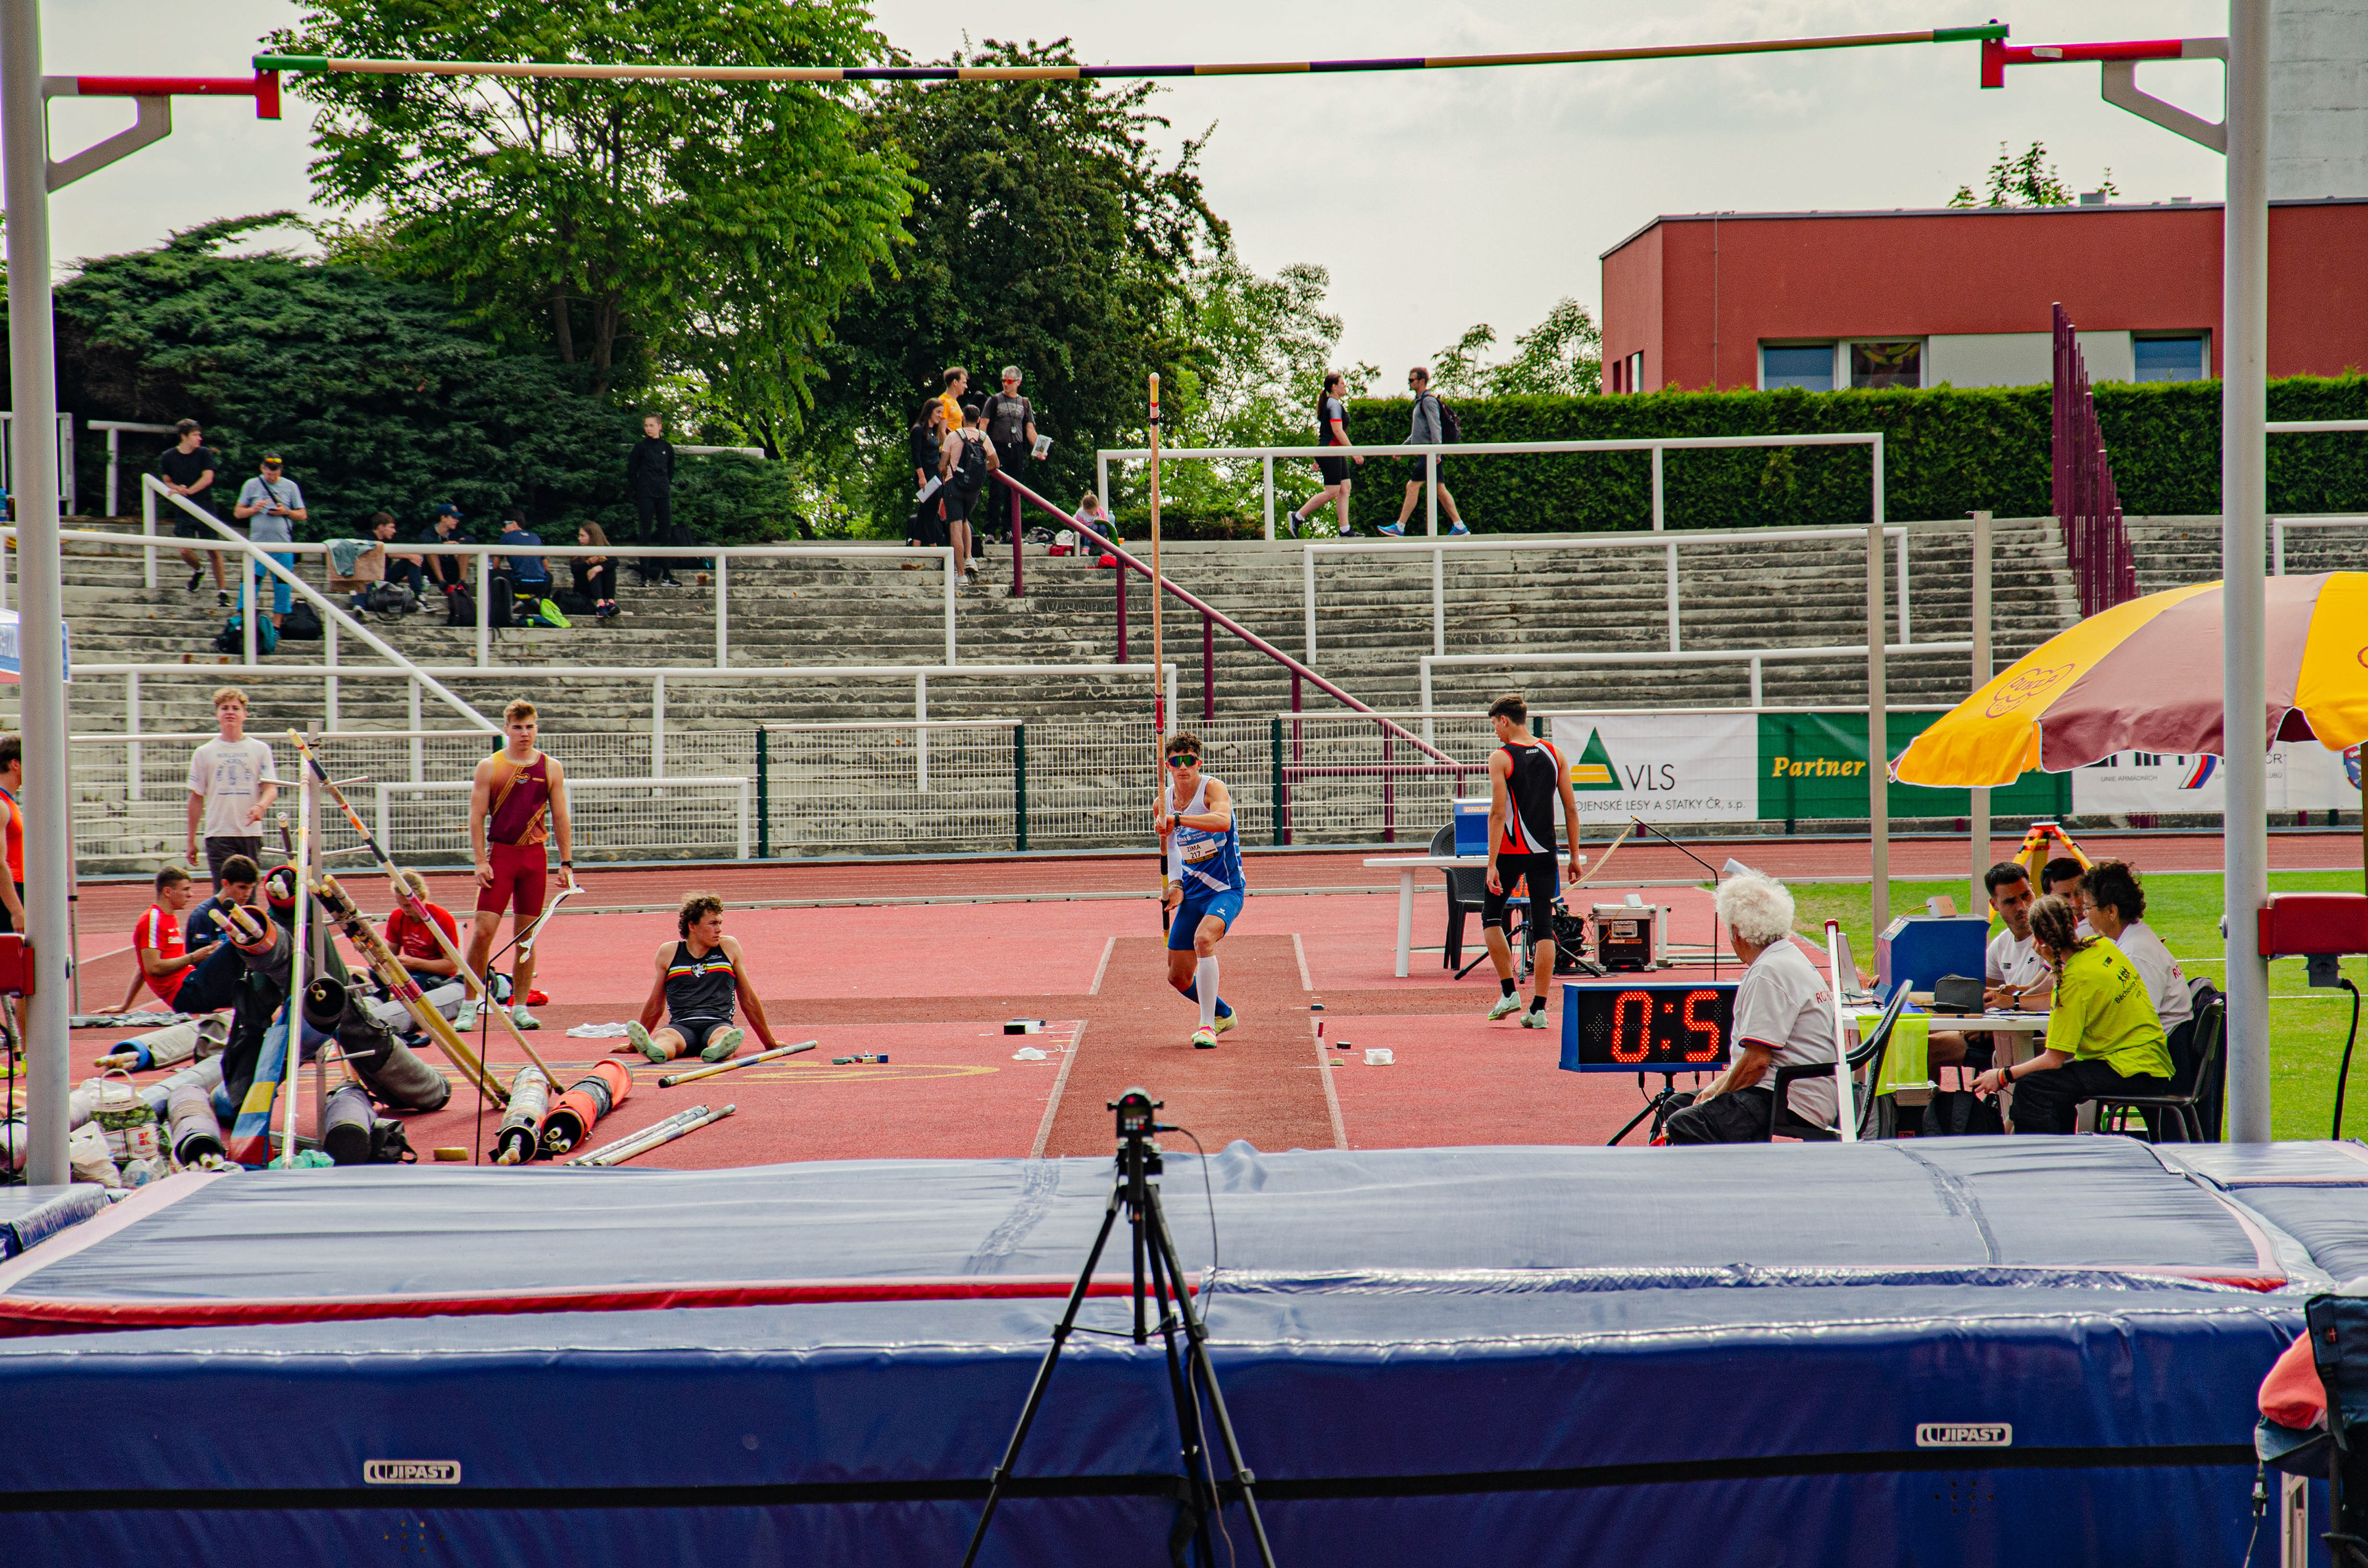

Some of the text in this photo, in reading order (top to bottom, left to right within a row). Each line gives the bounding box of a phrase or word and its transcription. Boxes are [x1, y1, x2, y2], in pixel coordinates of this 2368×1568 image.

[1772, 757, 1866, 778] Partner
[1626, 764, 1675, 791] VLS
[1576, 798, 1622, 811] OJENSKÉ
[1626, 800, 1651, 811] LESY
[1654, 800, 1662, 810] A
[1666, 798, 1703, 810] STATKY
[1728, 800, 1746, 811] s.p.
[1186, 844, 1201, 852] ZÍMA
[1190, 851, 1201, 859] 217
